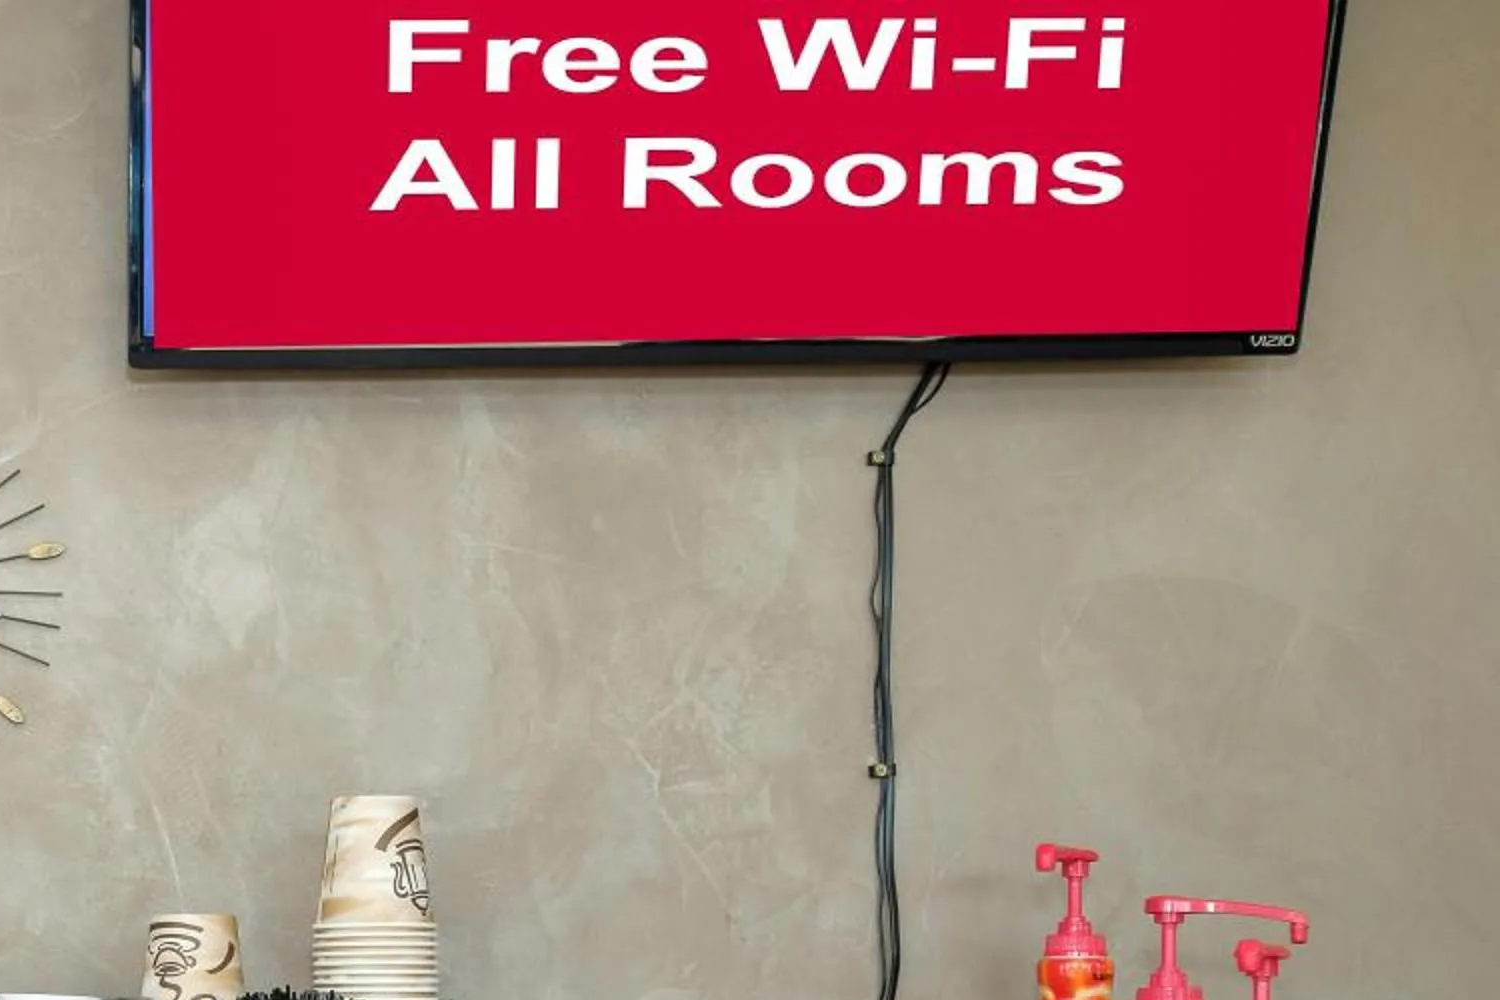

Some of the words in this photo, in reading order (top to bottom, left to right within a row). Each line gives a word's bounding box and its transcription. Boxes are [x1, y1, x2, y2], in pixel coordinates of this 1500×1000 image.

[387, 19, 709, 94] Free
[757, 17, 1126, 91] Wi-Fi
[368, 137, 561, 212] All
[621, 136, 1125, 209] Rooms
[1251, 335, 1295, 347] VIZIO
